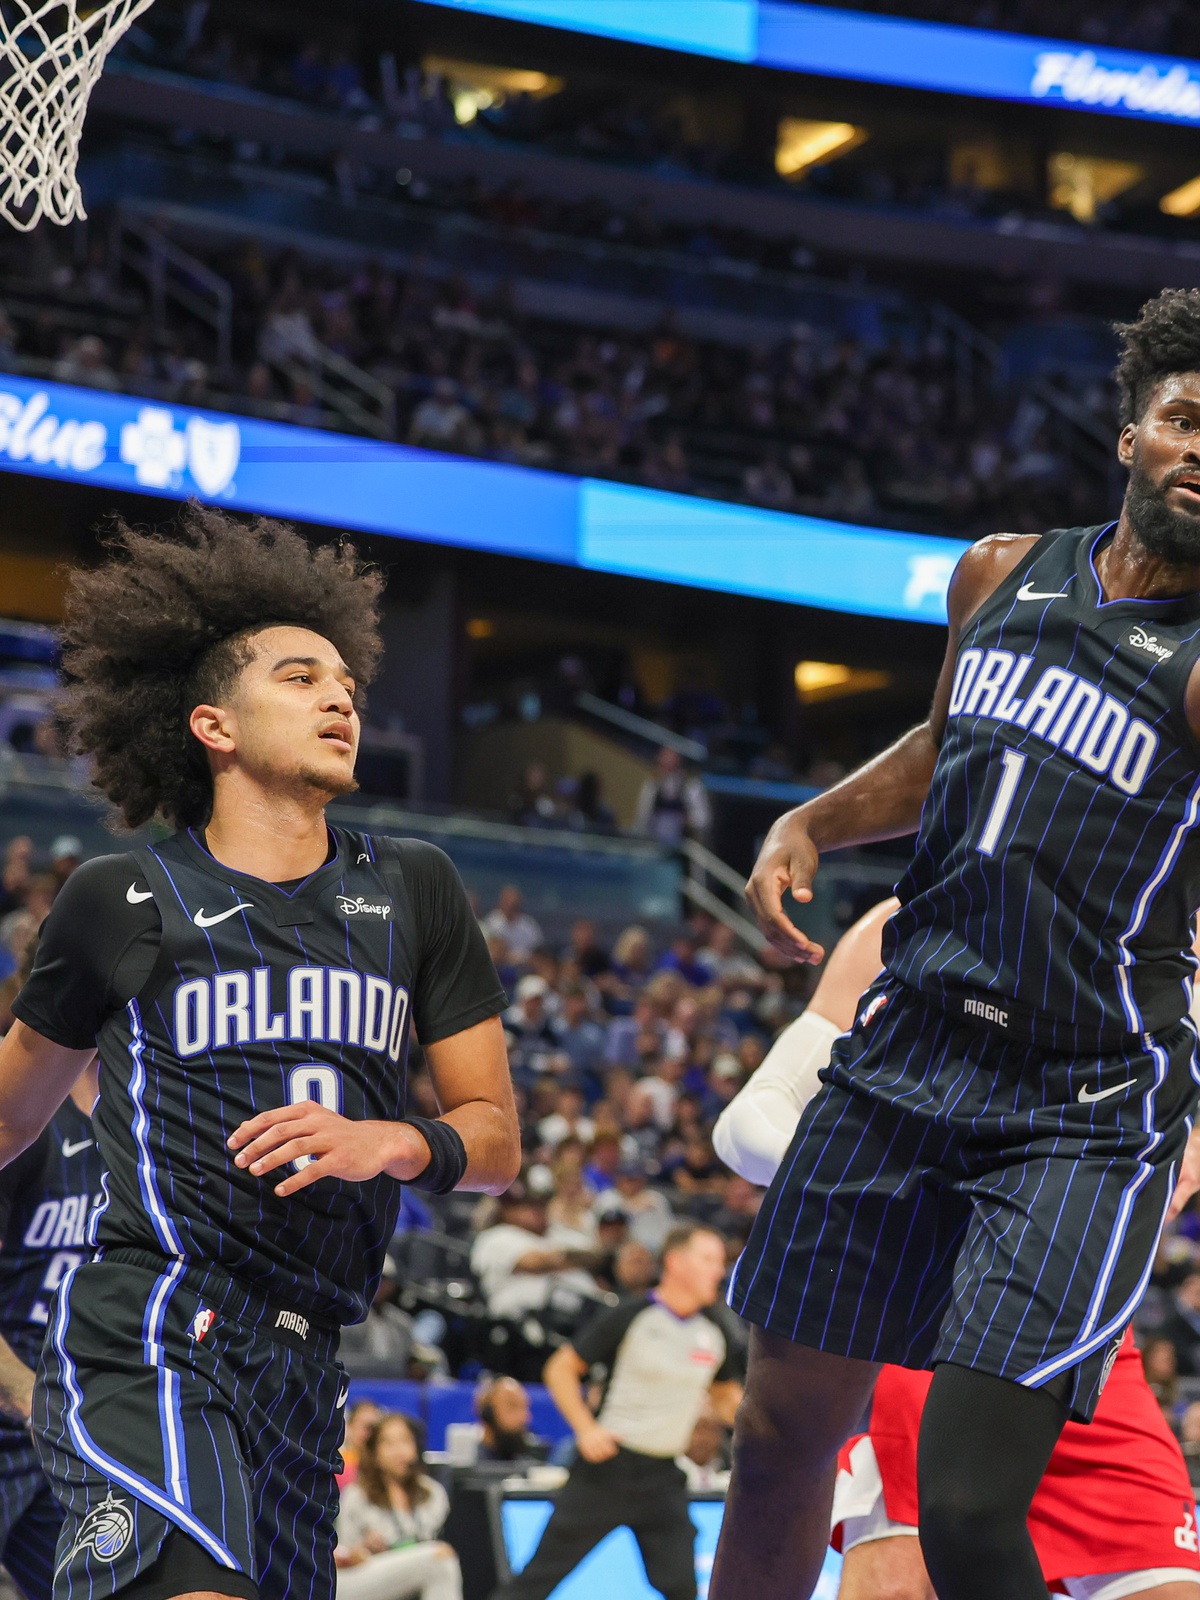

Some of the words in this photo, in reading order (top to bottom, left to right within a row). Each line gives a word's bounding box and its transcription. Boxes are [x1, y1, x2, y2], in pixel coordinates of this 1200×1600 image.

[1128, 625, 1174, 663] Disney
[949, 648, 1160, 797] ORLANDO
[976, 745, 1028, 858] 1
[335, 895, 391, 920] Disney
[174, 966, 409, 1063] ORLANDO
[964, 999, 1009, 1028] MAGIC
[23, 1193, 102, 1248] ORL
[274, 1310, 310, 1341] MAGIC
